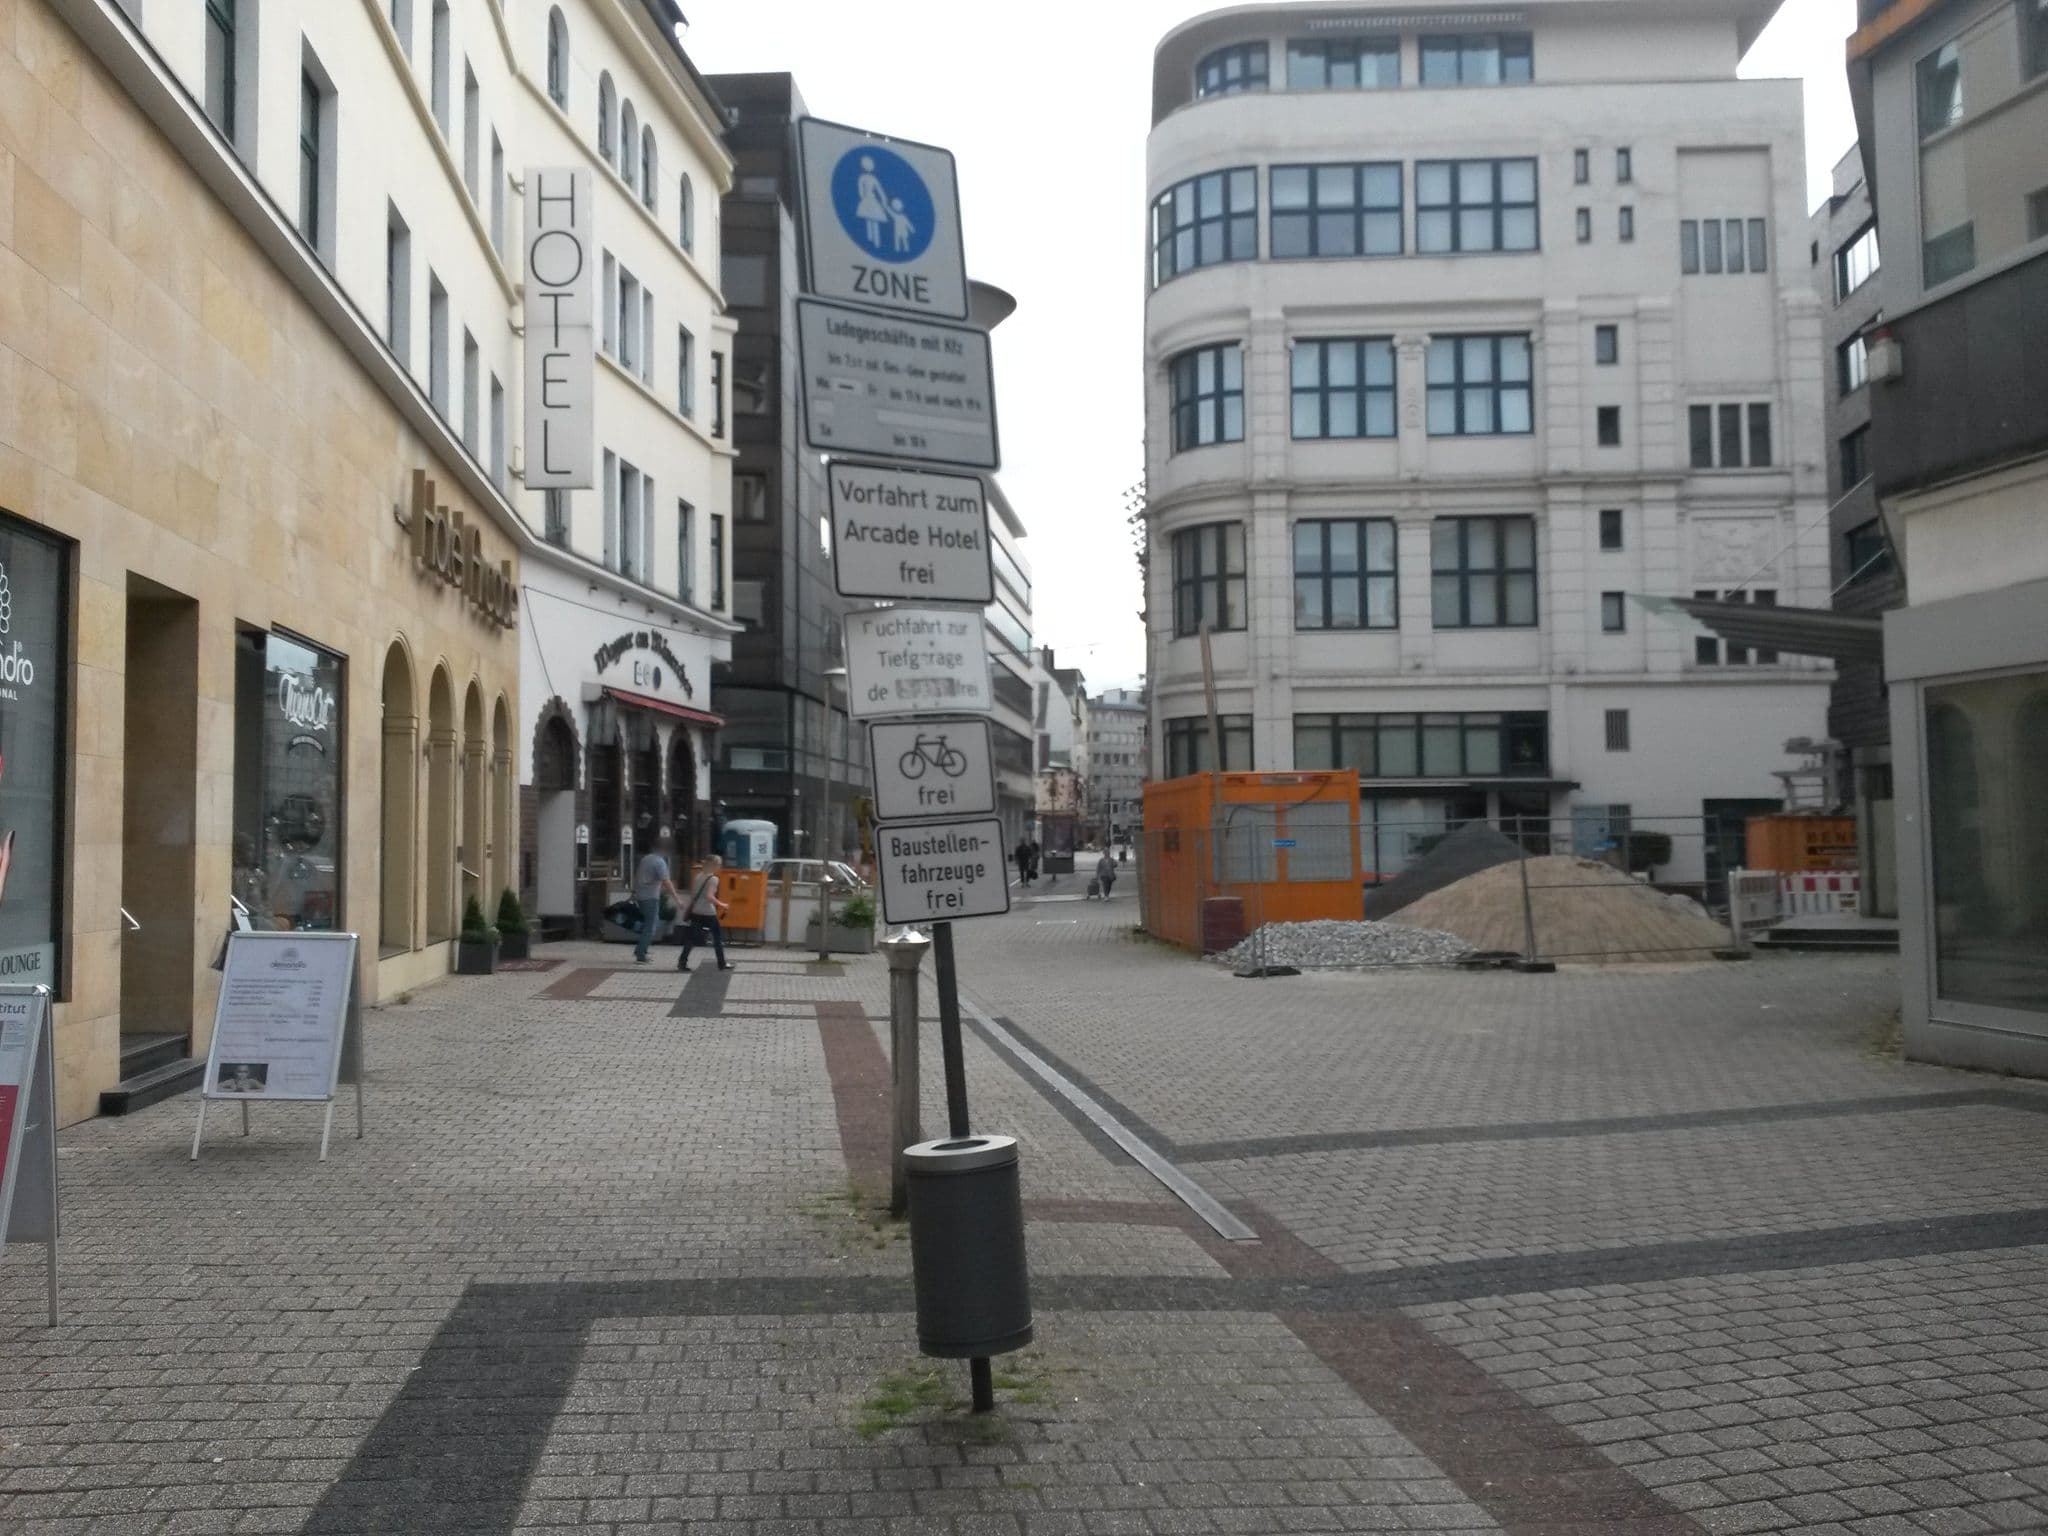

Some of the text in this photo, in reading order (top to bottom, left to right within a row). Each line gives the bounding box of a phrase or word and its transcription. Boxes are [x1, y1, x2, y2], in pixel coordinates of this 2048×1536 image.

[852, 265, 931, 304] ZONE
[530, 173, 583, 475] HOTEL
[839, 479, 978, 514] Vorfahrt zum
[844, 519, 980, 551] Arcade Hotel
[900, 560, 935, 584] frei
[918, 784, 955, 805] frei
[891, 833, 990, 857] Baustellen-
[901, 862, 985, 884] fahrzeuge
[926, 888, 964, 909] frei
[0, 951, 41, 976] OUNGE
